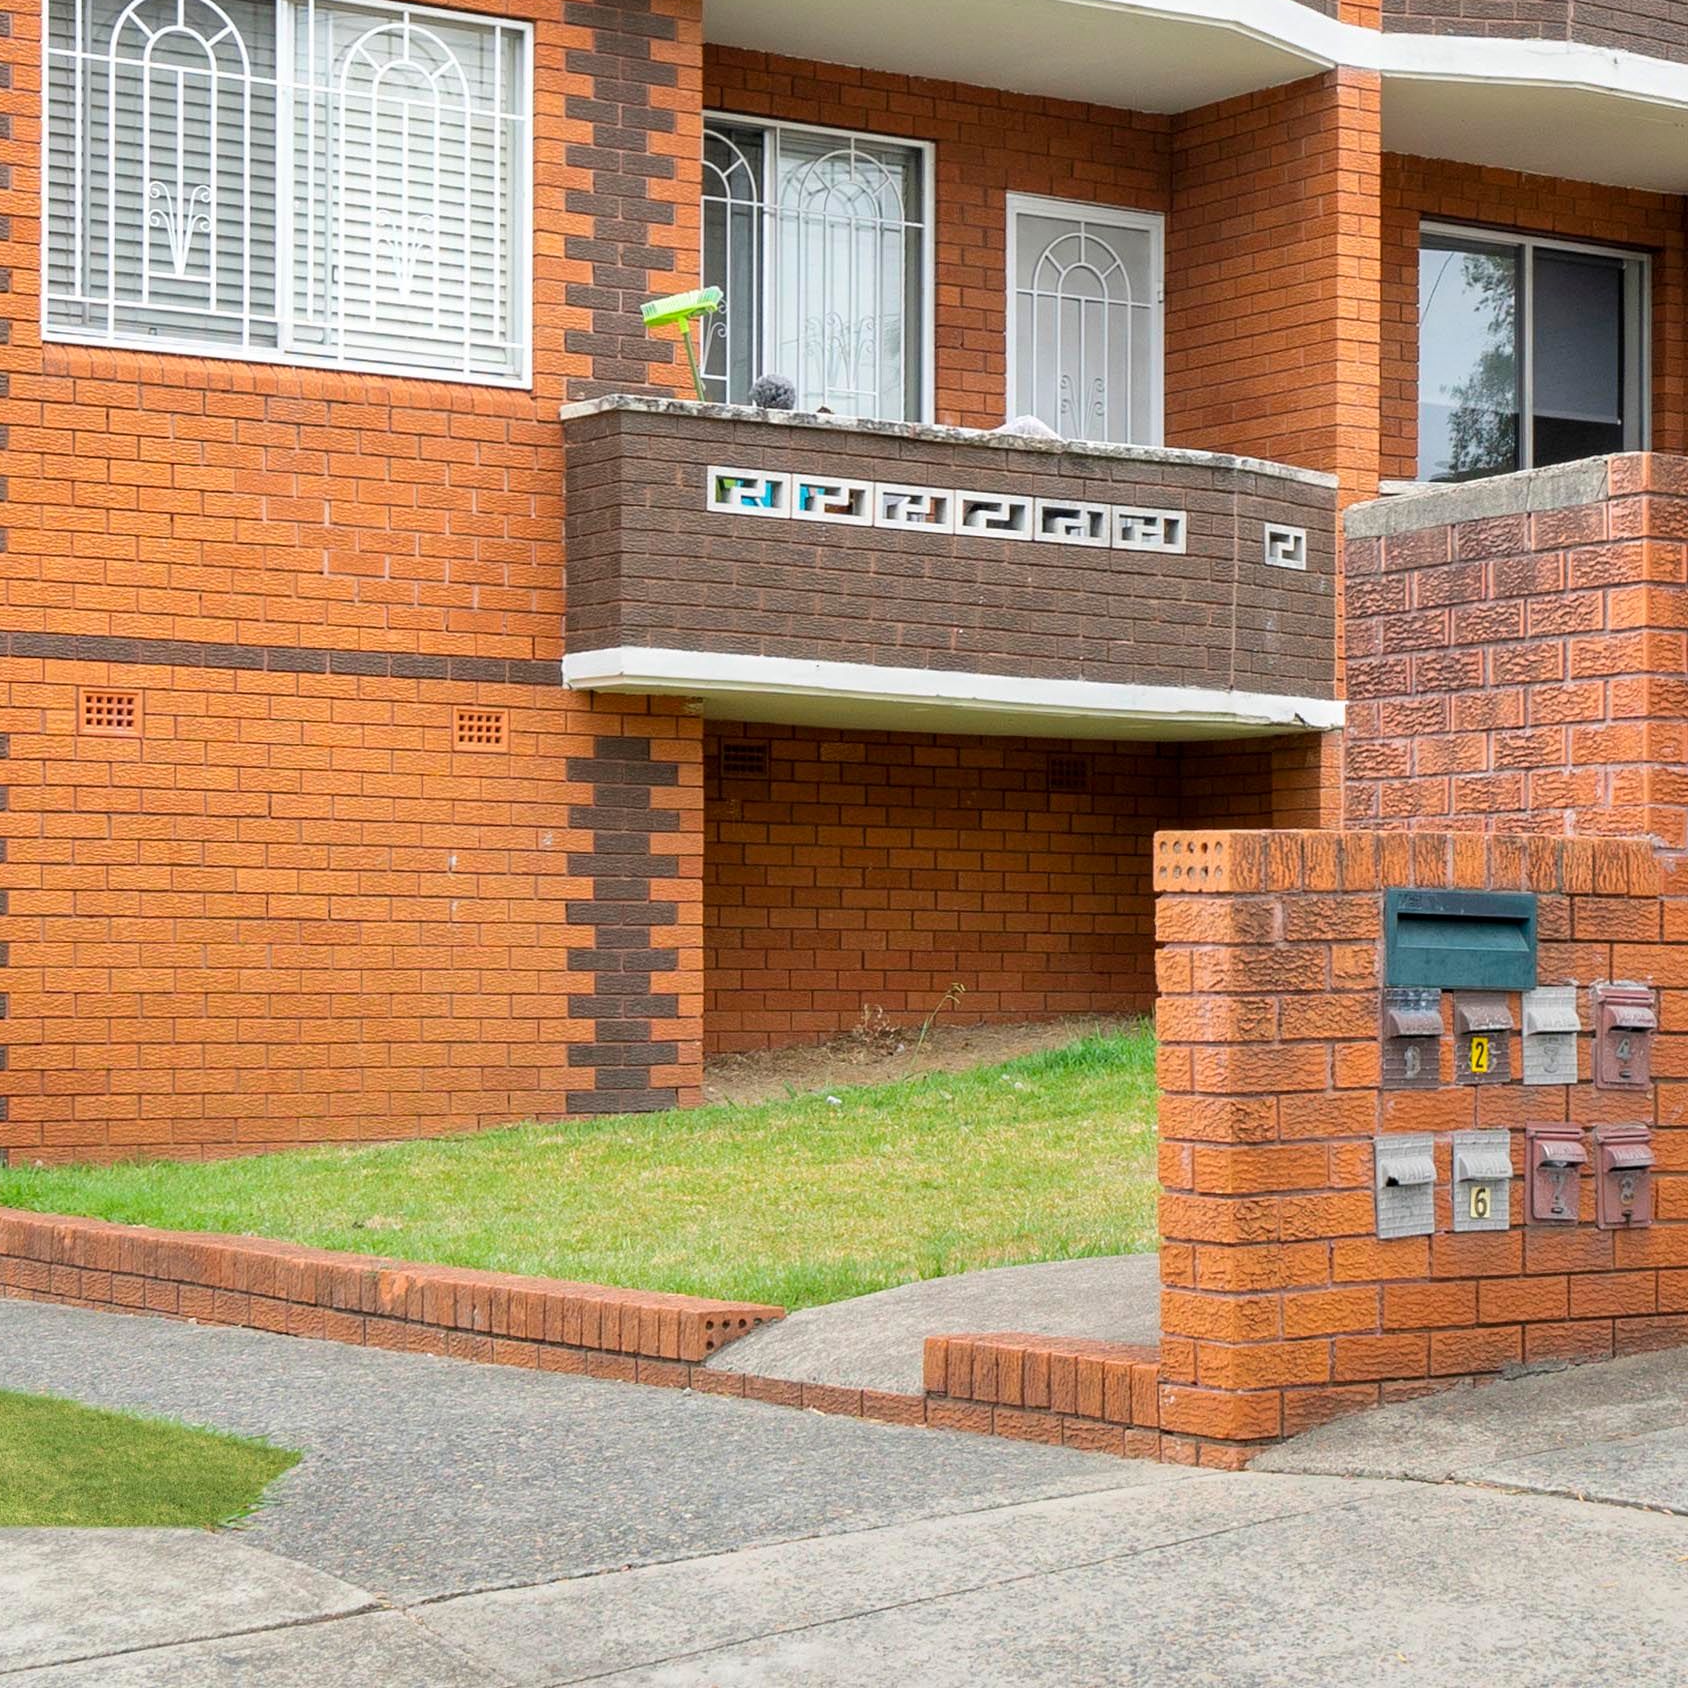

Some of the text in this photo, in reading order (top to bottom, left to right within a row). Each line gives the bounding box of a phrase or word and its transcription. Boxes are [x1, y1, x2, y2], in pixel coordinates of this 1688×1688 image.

[1475, 1041, 1484, 1069] 2
[1616, 1038, 1632, 1064] 4
[1474, 1187, 1488, 1218] 6
